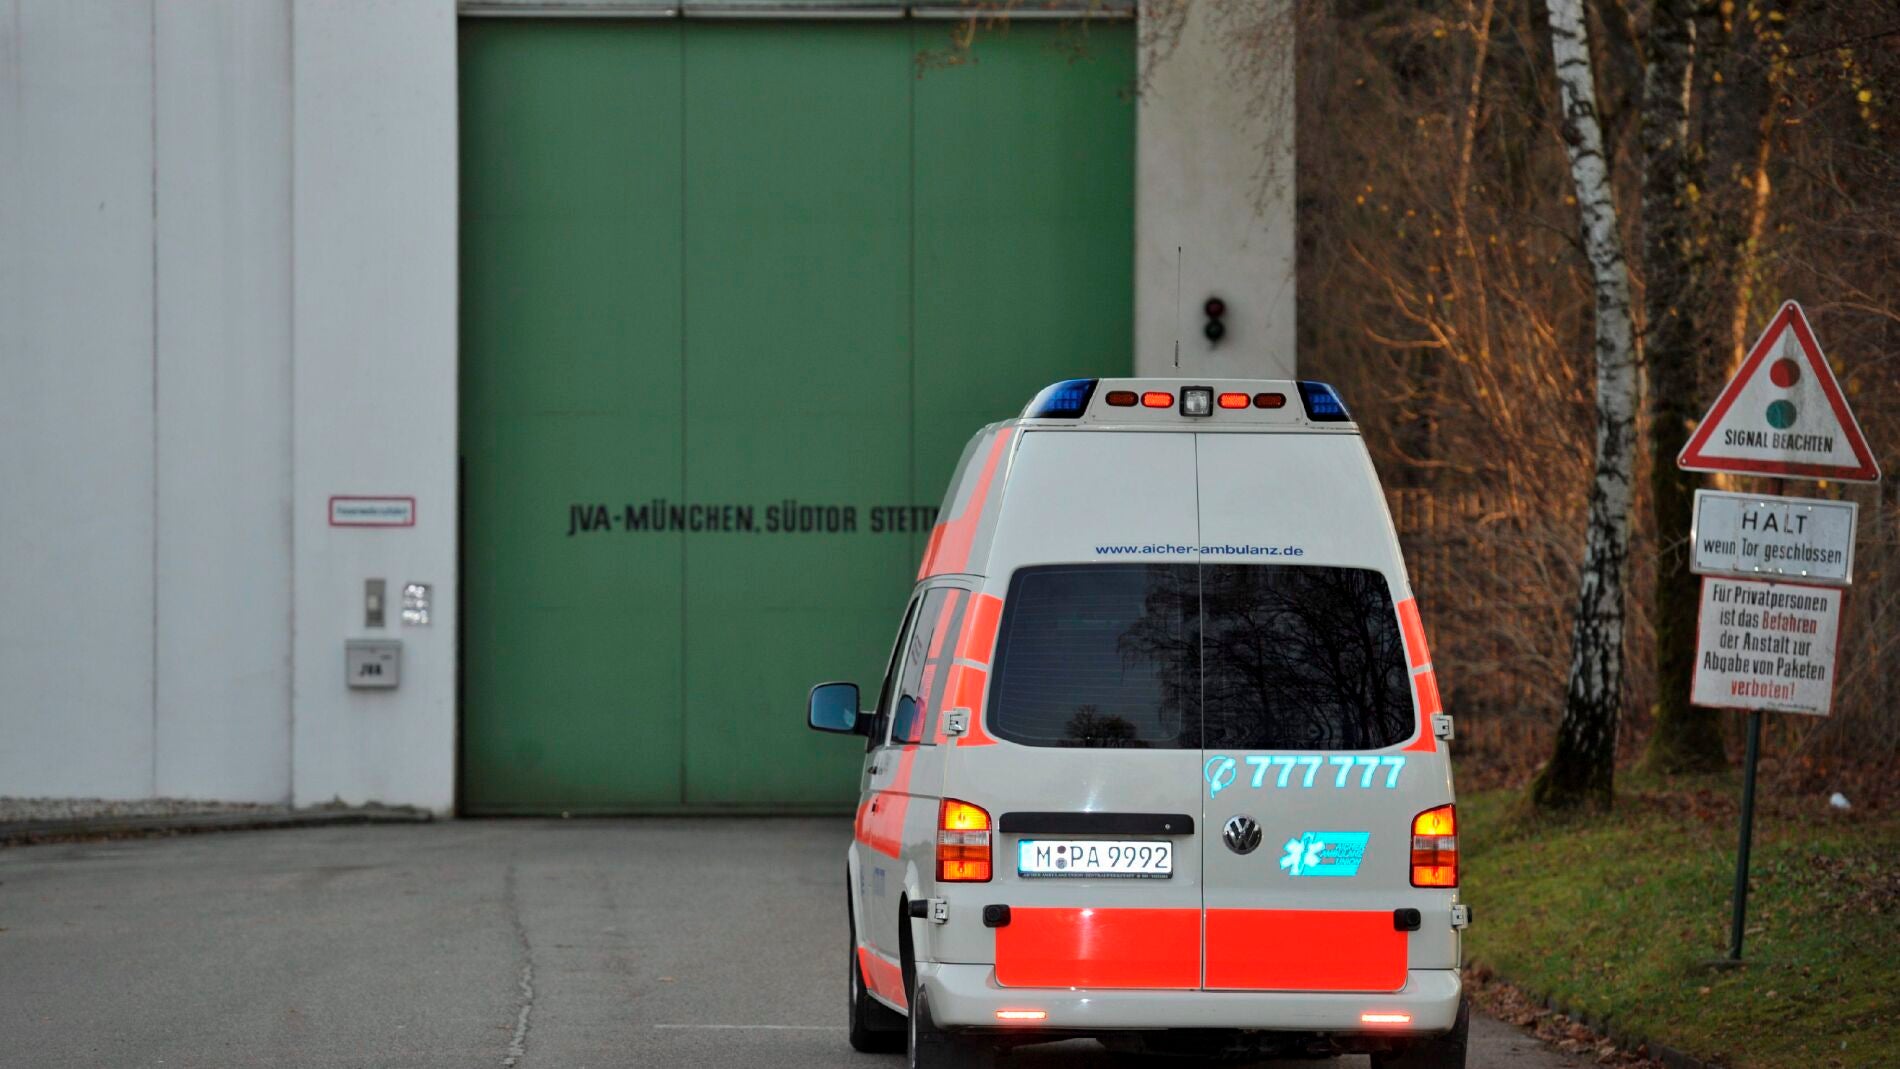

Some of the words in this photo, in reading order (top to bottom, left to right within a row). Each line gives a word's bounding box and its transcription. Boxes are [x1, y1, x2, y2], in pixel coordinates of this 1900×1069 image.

[1724, 428, 1768, 449] SIGNAL
[1772, 432, 1833, 453] BEACHTEN
[766, 498, 856, 533] SÜDTOR
[1741, 511, 1807, 534] HALT
[1095, 543, 1304, 557] www.aicher-ambulanz.de
[1703, 537, 1736, 555] wenn
[1741, 537, 1758, 557] Tor
[1763, 542, 1841, 564] geschlossen
[1712, 584, 1732, 602] Für
[1734, 585, 1827, 612] Privatpersonen
[1719, 607, 1735, 626] ist
[1737, 609, 1758, 628] das
[1762, 611, 1817, 634] Befahren
[1719, 630, 1739, 650] der
[1742, 632, 1789, 655] Anstalt
[1703, 651, 1749, 674] Abgabe
[1752, 661, 1773, 675] von
[1776, 657, 1825, 680] Paketen
[1731, 678, 1795, 701] verboten!
[1244, 756, 1323, 788] 777
[1328, 756, 1405, 789] 777
[1036, 846, 1050, 867] M
[1069, 846, 1099, 868] PA
[1108, 847, 1168, 868] 9992
